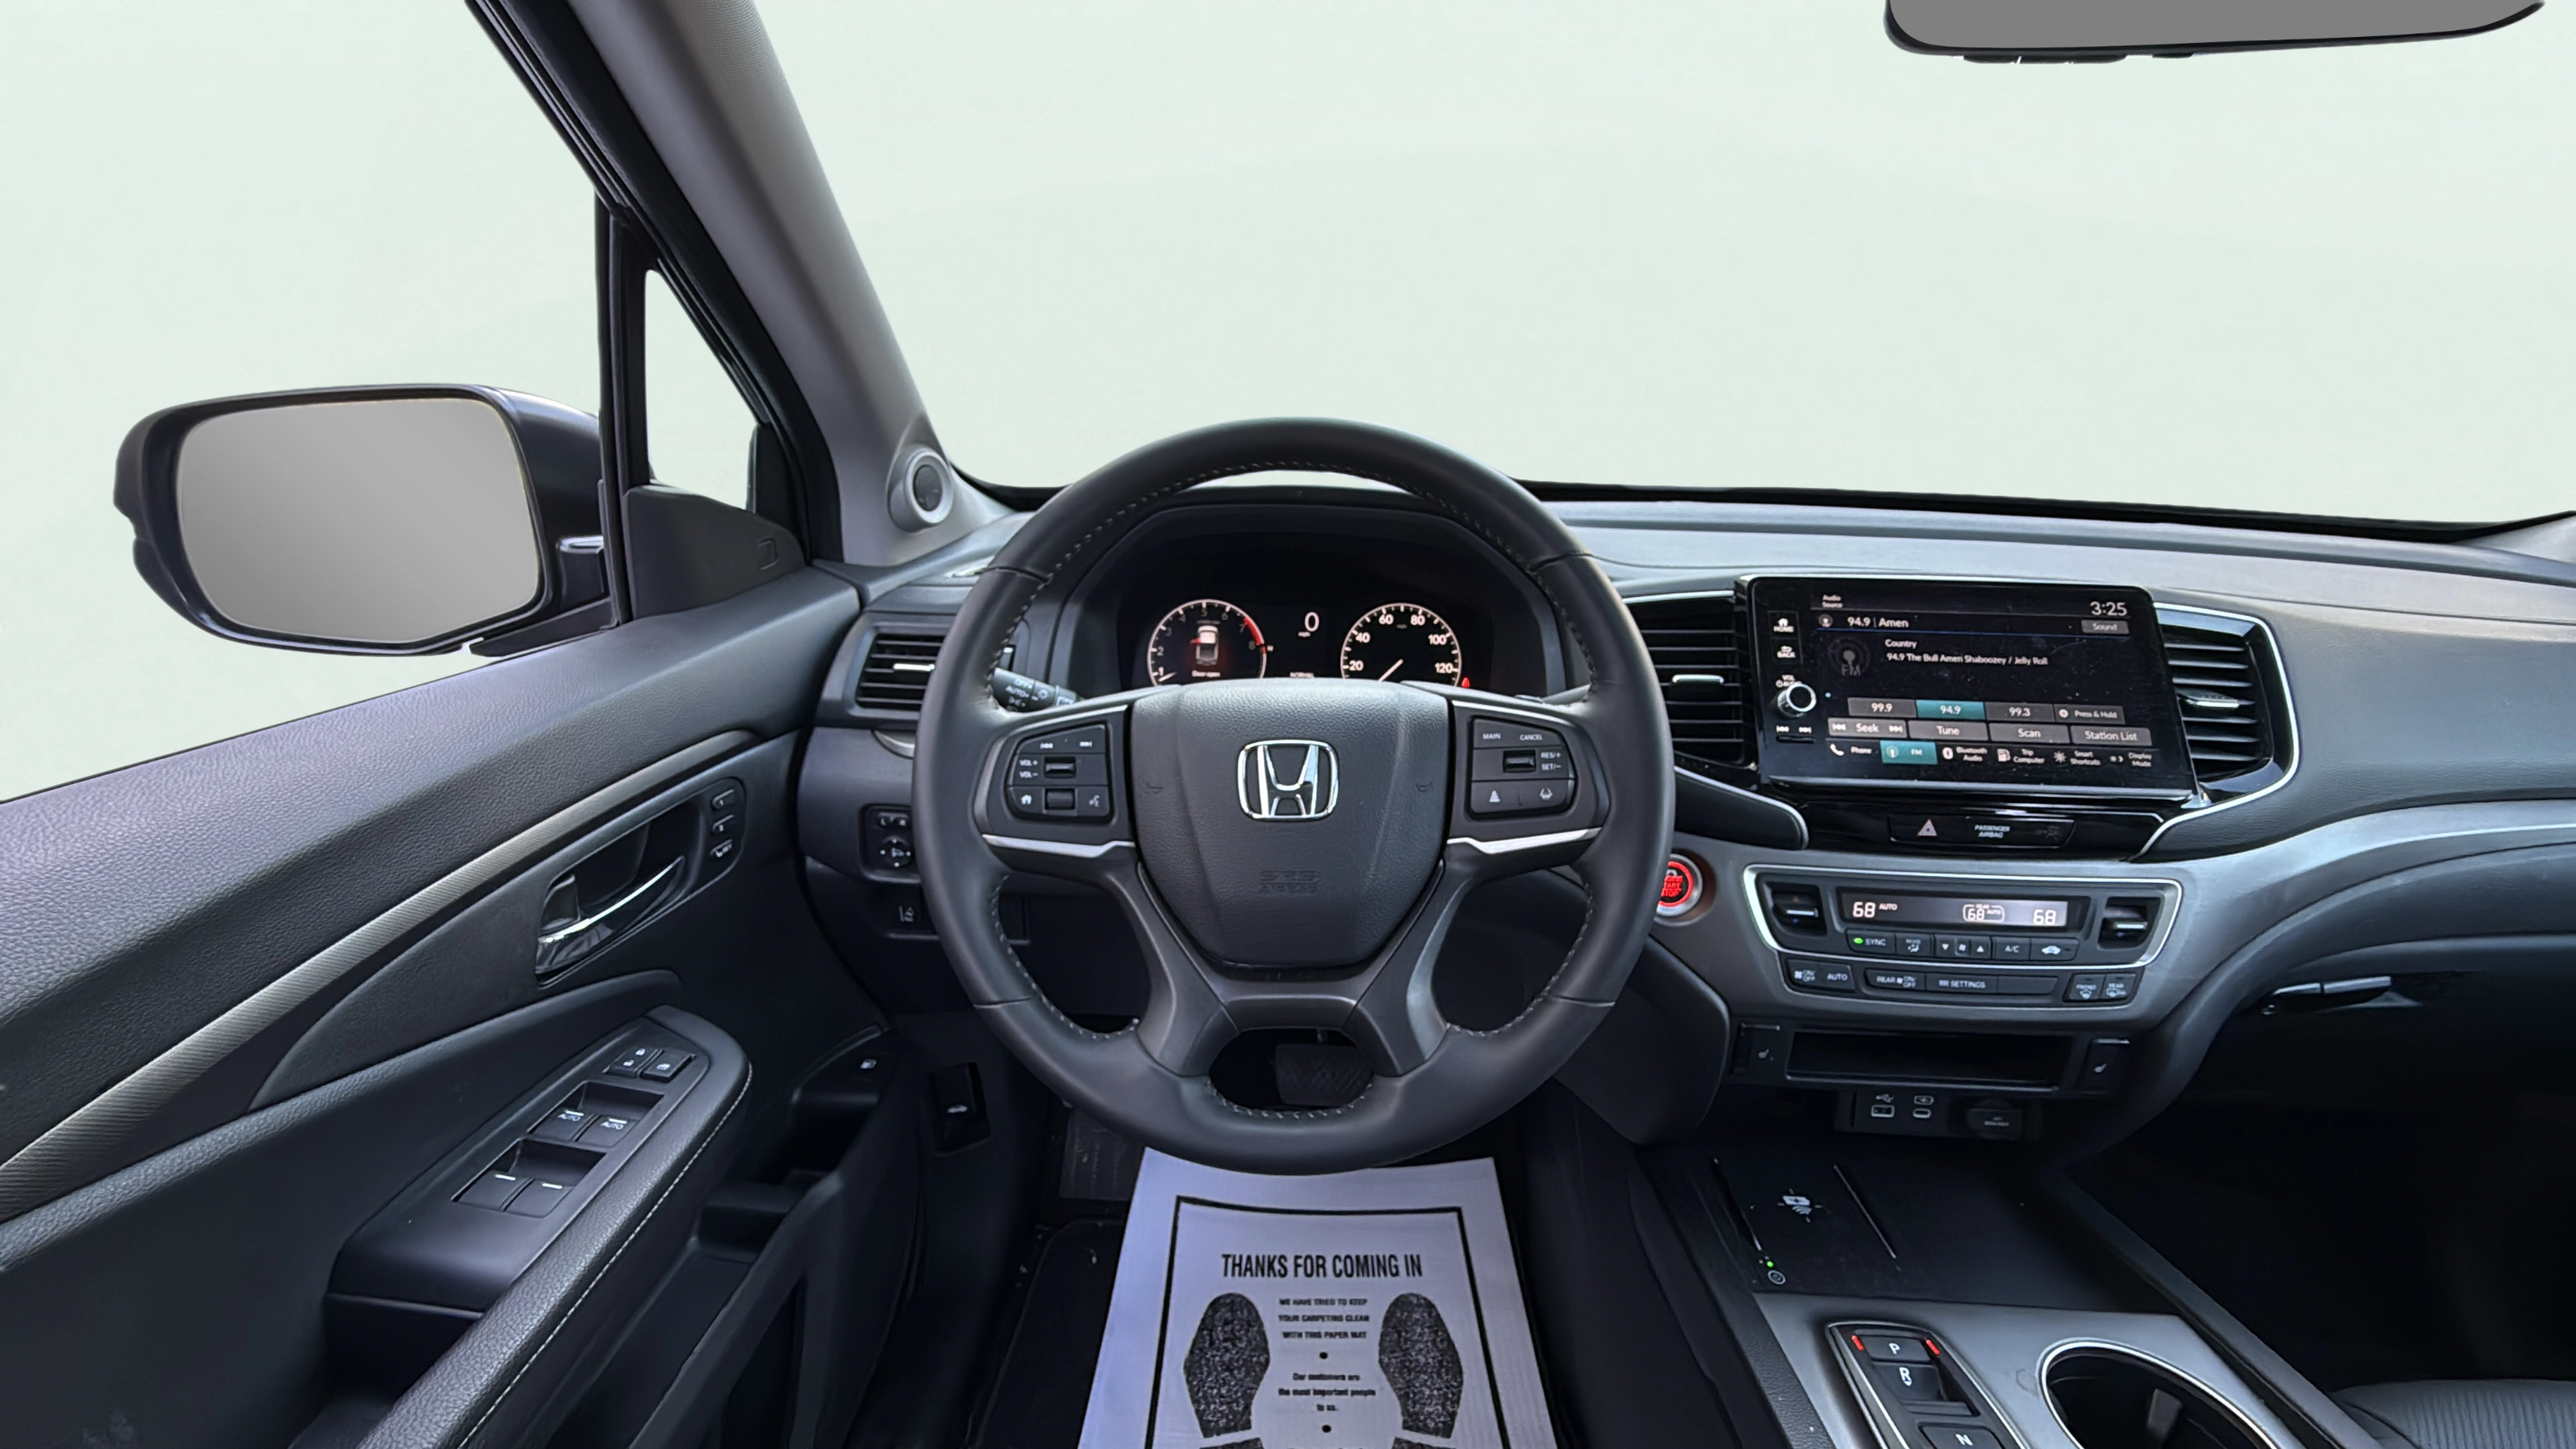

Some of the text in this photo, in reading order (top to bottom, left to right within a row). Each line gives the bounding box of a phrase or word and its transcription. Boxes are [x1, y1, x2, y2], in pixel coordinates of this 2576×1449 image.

[2090, 601, 2128, 616] 3:25
[1304, 611, 1319, 631] 0
[1379, 614, 1394, 625] 60
[1410, 614, 1425, 626] 80
[1847, 616, 1909, 628] 94.9 Amen
[2092, 623, 2117, 631] Sound
[1355, 632, 1370, 643] 40
[1428, 634, 1447, 645] 100
[1885, 639, 1917, 649] Country
[1887, 652, 1905, 661] 94.9
[1906, 653, 1922, 661] The
[1923, 653, 1938, 662] Bull
[1940, 654, 1963, 663] Amen
[1964, 655, 2006, 665] Shaboozey
[2014, 657, 2030, 666] Jelly
[2032, 657, 2048, 665] Roll
[1349, 660, 1364, 671] 20
[1434, 662, 1453, 674] 120
[1841, 665, 1861, 676] FM
[1871, 702, 1892, 712] 99.9
[1940, 705, 1961, 714] 94.9
[2009, 707, 2030, 716] 99.3
[2074, 710, 2092, 718] Press
[1856, 723, 1879, 733] Seek
[1936, 725, 1960, 736] Tune
[2018, 728, 2041, 737] Scan
[2085, 730, 2137, 741] Station List
[1851, 746, 1872, 754] Phone
[1956, 746, 1988, 755] Bluetooth
[2021, 748, 2034, 756] Trip
[2013, 756, 2045, 764] Computer
[2128, 752, 2152, 760] Display
[2070, 758, 2101, 766] Shortcuts
[1853, 901, 1876, 918] 68
[1967, 908, 1985, 920] 68
[2033, 909, 2056, 925] 68
[2005, 945, 2020, 953] A/C
[1950, 980, 1986, 989] SETTINGS
[601, 1122, 624, 1130] AUTO
[1221, 1254, 1423, 1278] THANKS FOR COMING IN
[1888, 1343, 1900, 1355] P
[1899, 1366, 1911, 1382] R
[1955, 1433, 1973, 1446] N
